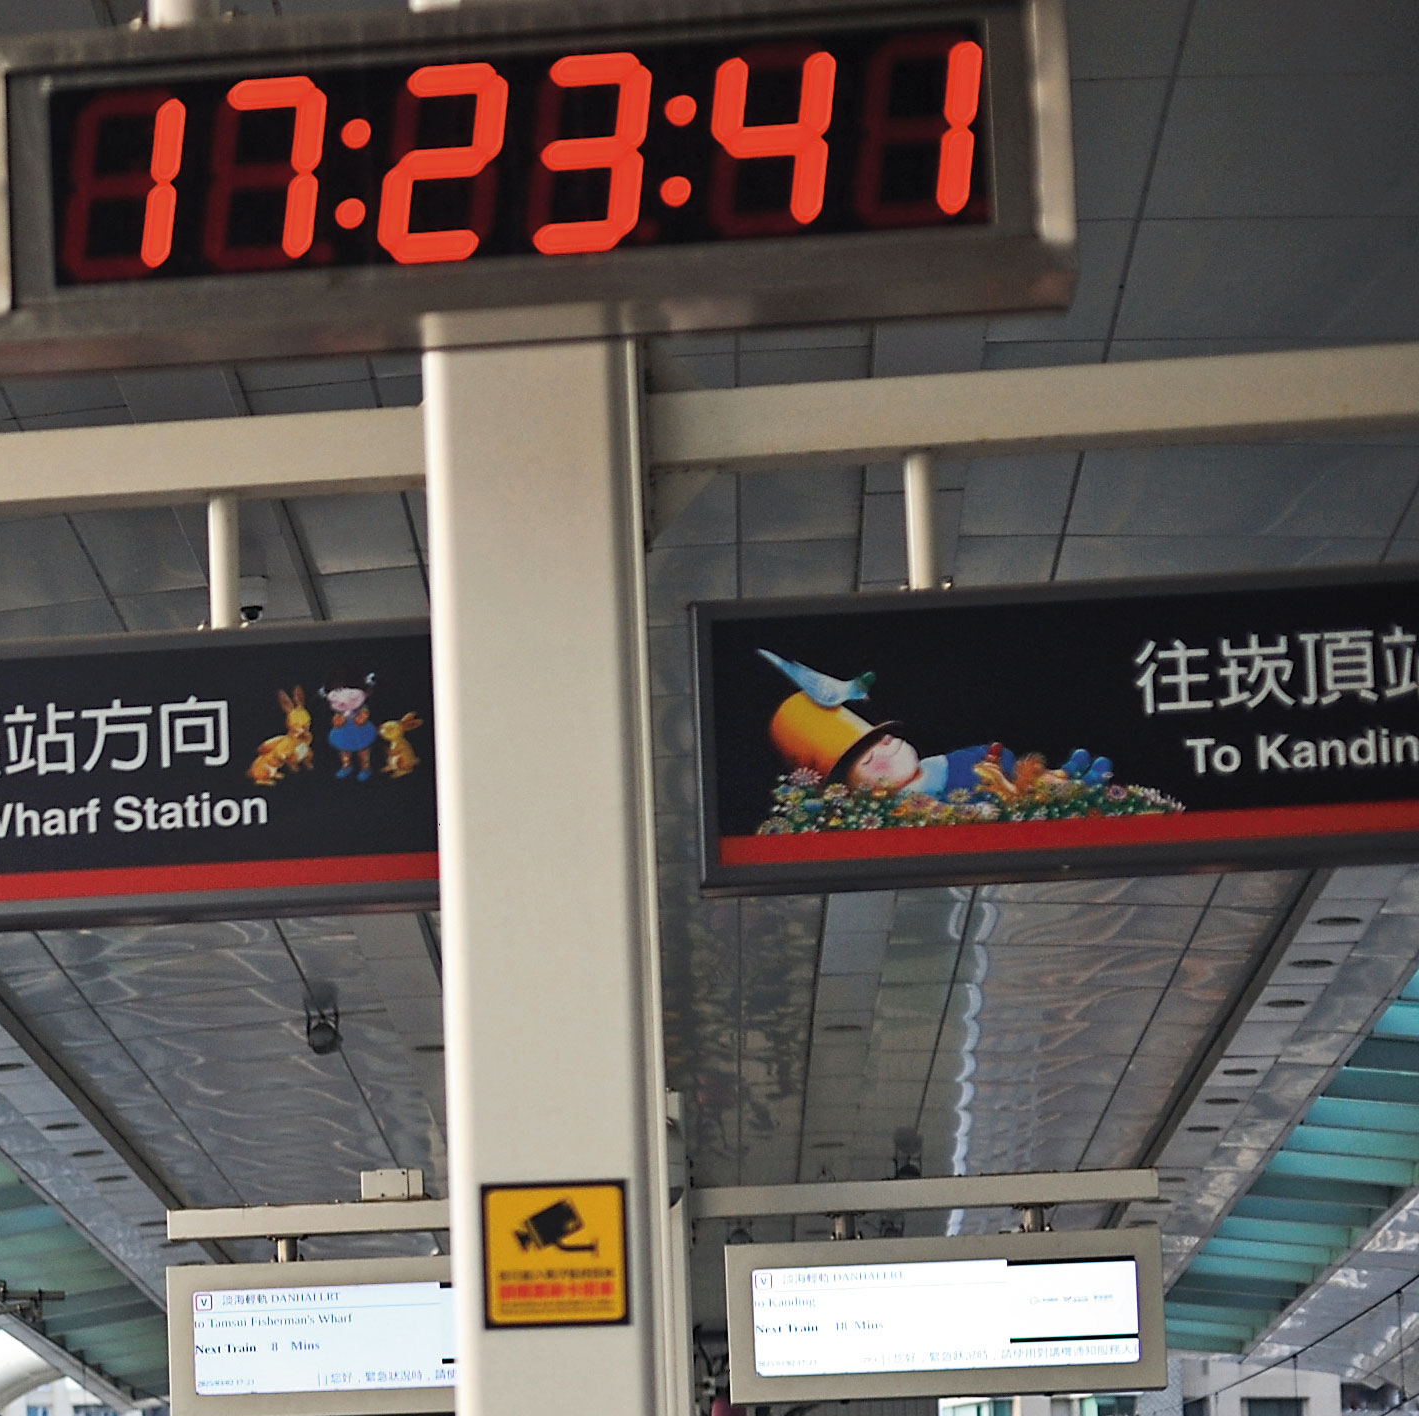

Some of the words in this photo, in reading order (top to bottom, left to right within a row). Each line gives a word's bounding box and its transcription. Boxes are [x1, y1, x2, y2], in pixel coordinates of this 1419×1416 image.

[139, 40, 984, 268] 17:23:41
[1185, 737, 1241, 774] To
[113, 791, 268, 833] Station
[200, 1298, 208, 1307] V
[271, 1292, 317, 1303] DANHAI
[769, 1296, 816, 1309] Kanding
[194, 1320, 205, 1329] to
[209, 1317, 247, 1329] Tamsui
[318, 1313, 352, 1325] Wharf
[756, 1323, 782, 1334] Next
[787, 1323, 818, 1333] Train
[855, 1320, 884, 1331] Mins
[196, 1343, 222, 1355] Next
[226, 1343, 257, 1354] Train
[291, 1340, 321, 1352] Mins
